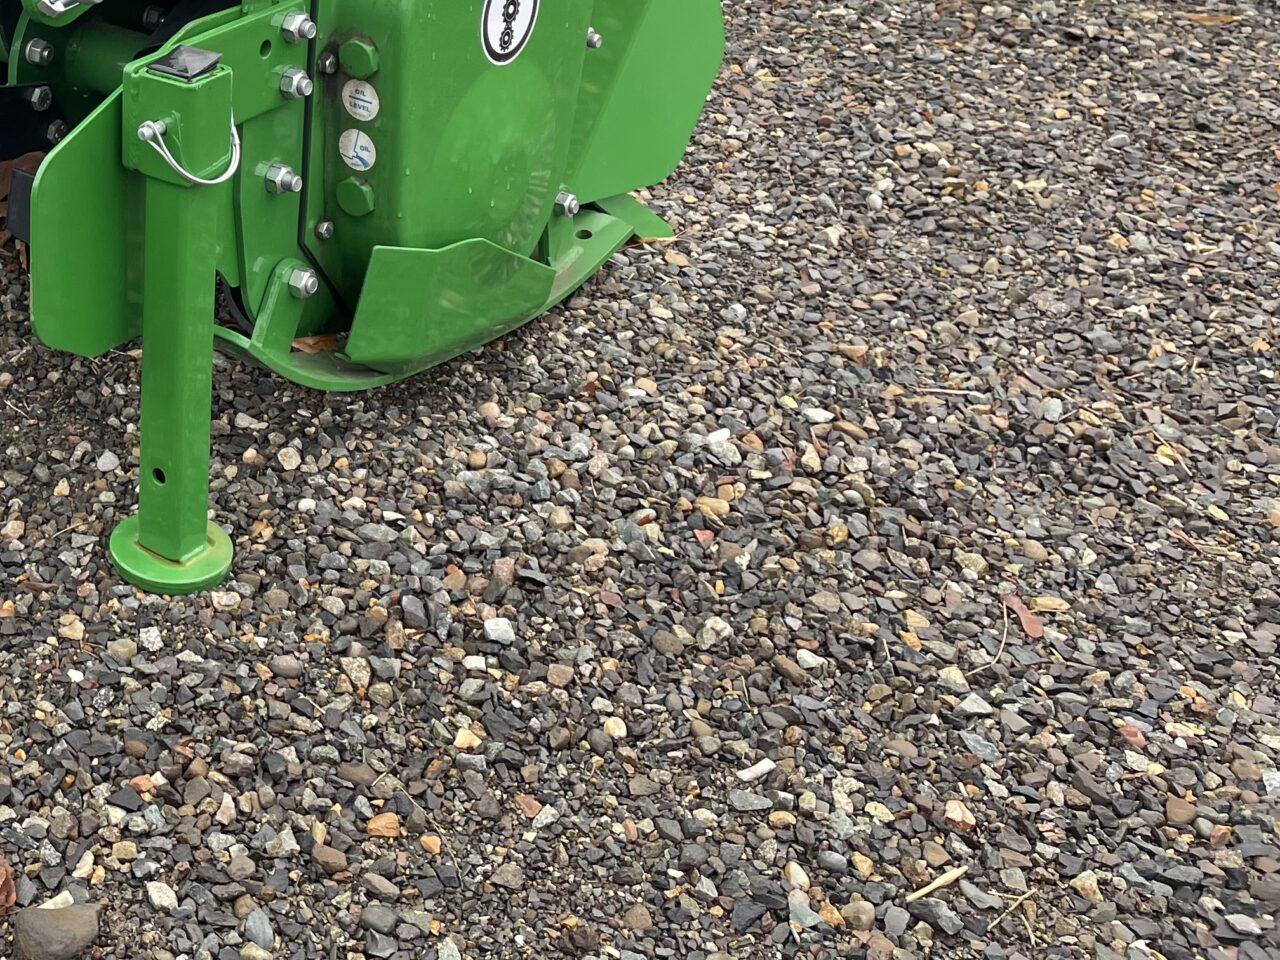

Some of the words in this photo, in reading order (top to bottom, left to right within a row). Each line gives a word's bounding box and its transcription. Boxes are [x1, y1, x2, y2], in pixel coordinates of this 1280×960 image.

[354, 88, 366, 97] OIL
[349, 101, 370, 113] LEVEL
[360, 145, 371, 153] OIL
